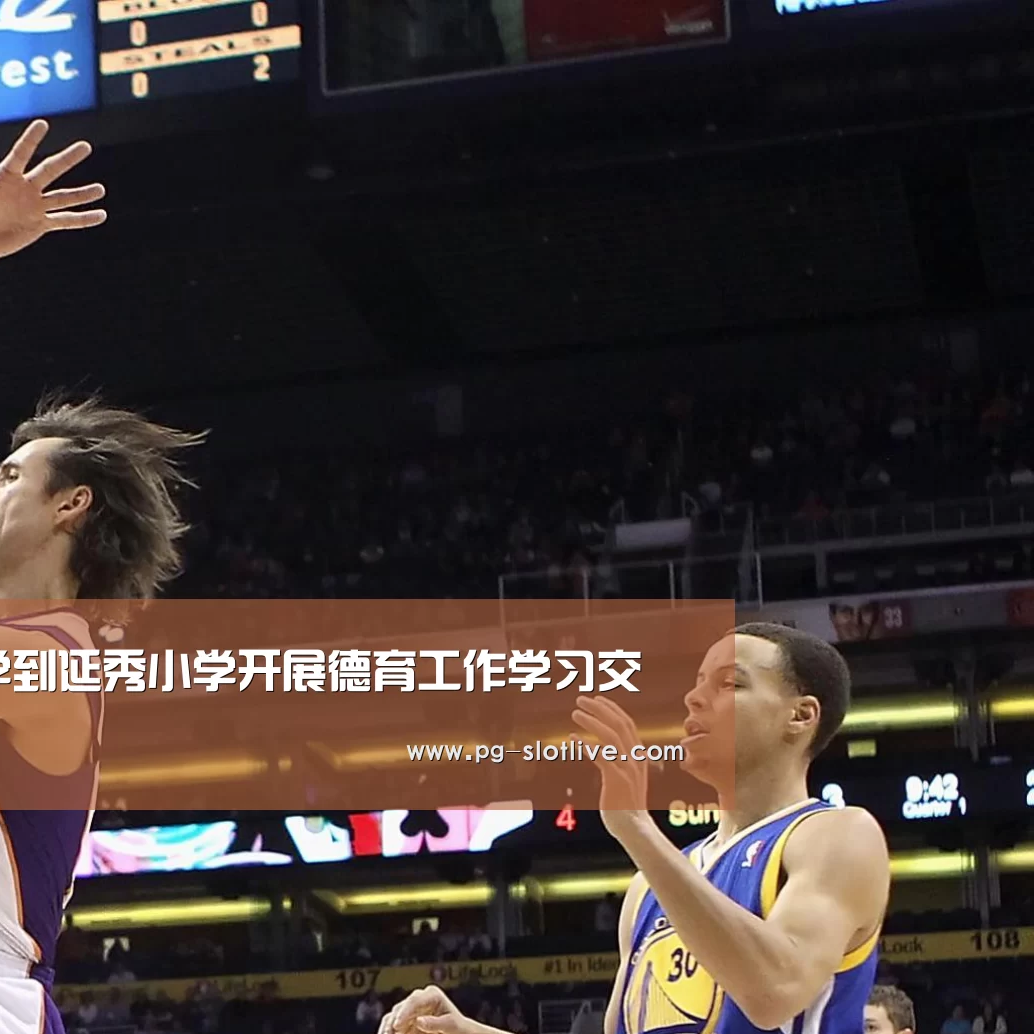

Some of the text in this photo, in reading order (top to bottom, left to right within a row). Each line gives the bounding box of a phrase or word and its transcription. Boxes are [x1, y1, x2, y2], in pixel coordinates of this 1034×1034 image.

[123, 35, 273, 66] STEALS
[253, 54, 270, 81] 2
[556, 804, 576, 831] 4
[668, 800, 720, 826] Sun
[970, 930, 1019, 951] 108
[667, 948, 697, 982] 30
[336, 968, 380, 990] 107
